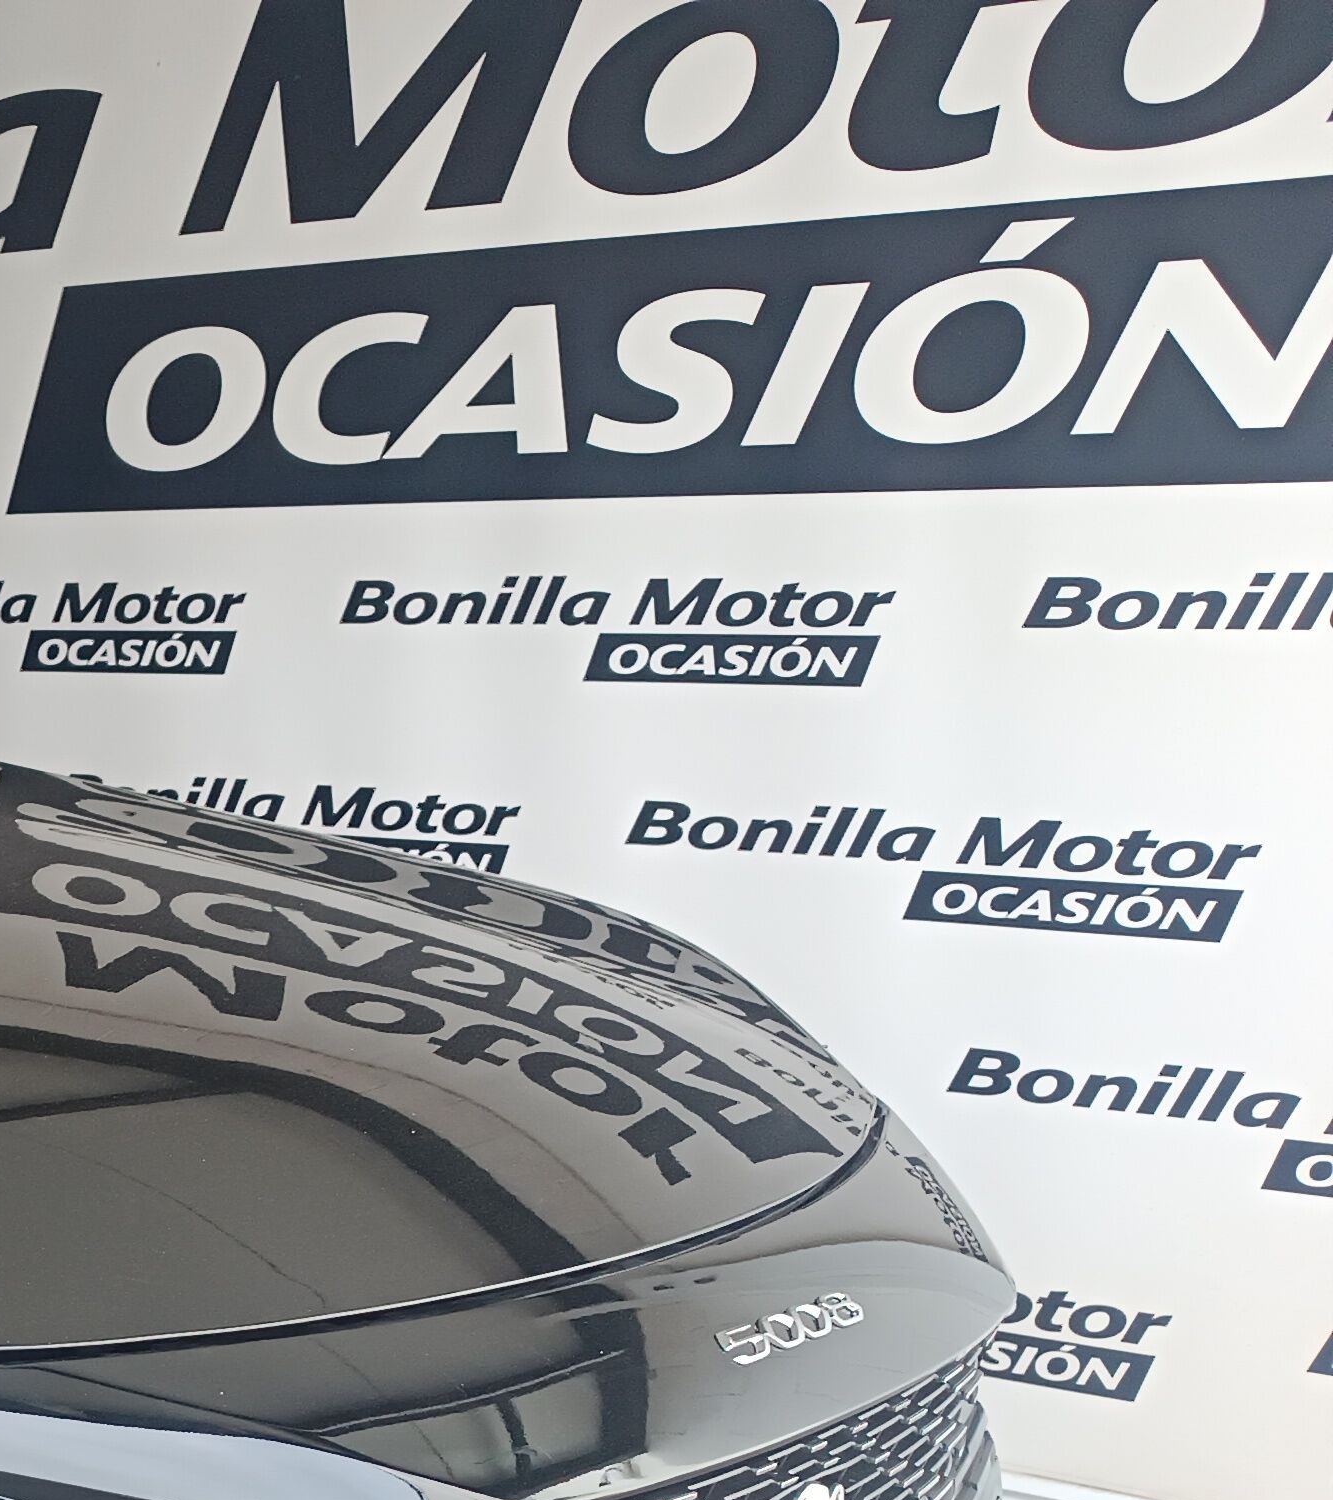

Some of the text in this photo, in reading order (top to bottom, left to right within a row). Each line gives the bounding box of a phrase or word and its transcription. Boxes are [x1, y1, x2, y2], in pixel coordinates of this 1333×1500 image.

[179, 0, 1333, 235] Moto
[106, 217, 1333, 473] OCASIÓN
[52, 583, 246, 624] Motor
[340, 576, 896, 627] Bonilla Motor
[1024, 573, 1333, 630] Bonill
[38, 633, 220, 667] OCASIÓN
[609, 638, 858, 677] OCASIÓN
[301, 785, 521, 836] Motor
[626, 801, 1262, 879] Bonilla Motor
[933, 884, 1218, 933] OCASIÓN
[947, 1048, 1300, 1129] Bonilla
[714, 1293, 864, 1365] 5008
